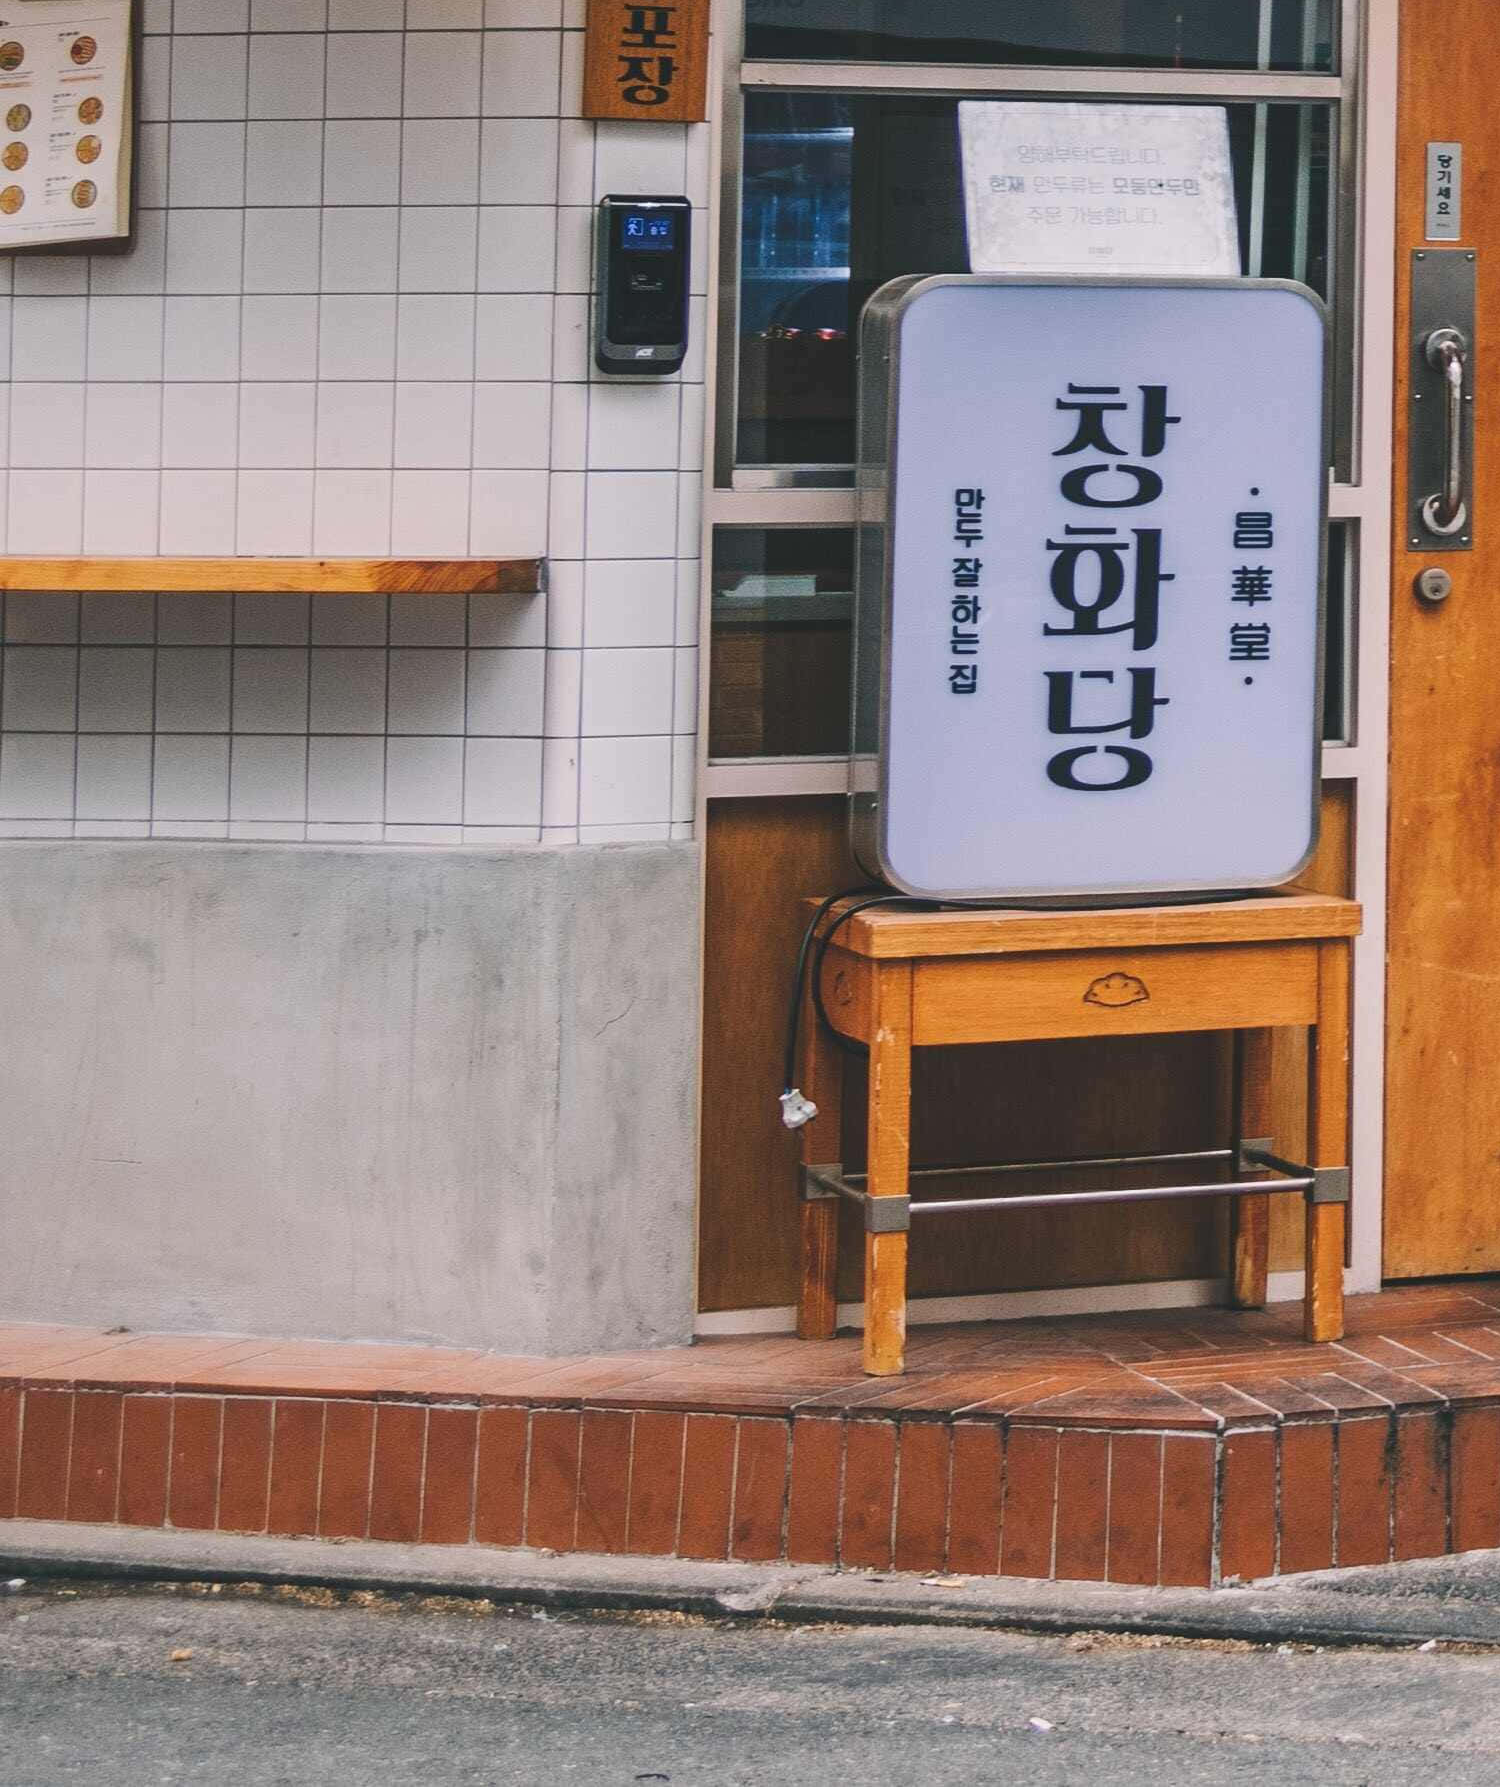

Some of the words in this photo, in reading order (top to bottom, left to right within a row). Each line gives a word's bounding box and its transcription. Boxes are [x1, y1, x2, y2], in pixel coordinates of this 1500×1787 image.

[1436, 154, 1453, 215] 당기세요
[954, 488, 986, 548] 만두
[949, 557, 984, 655] 잘하는
[1043, 382, 1182, 792] 창화당
[1229, 511, 1273, 662] 昌華堂
[948, 663, 978, 695] 집
